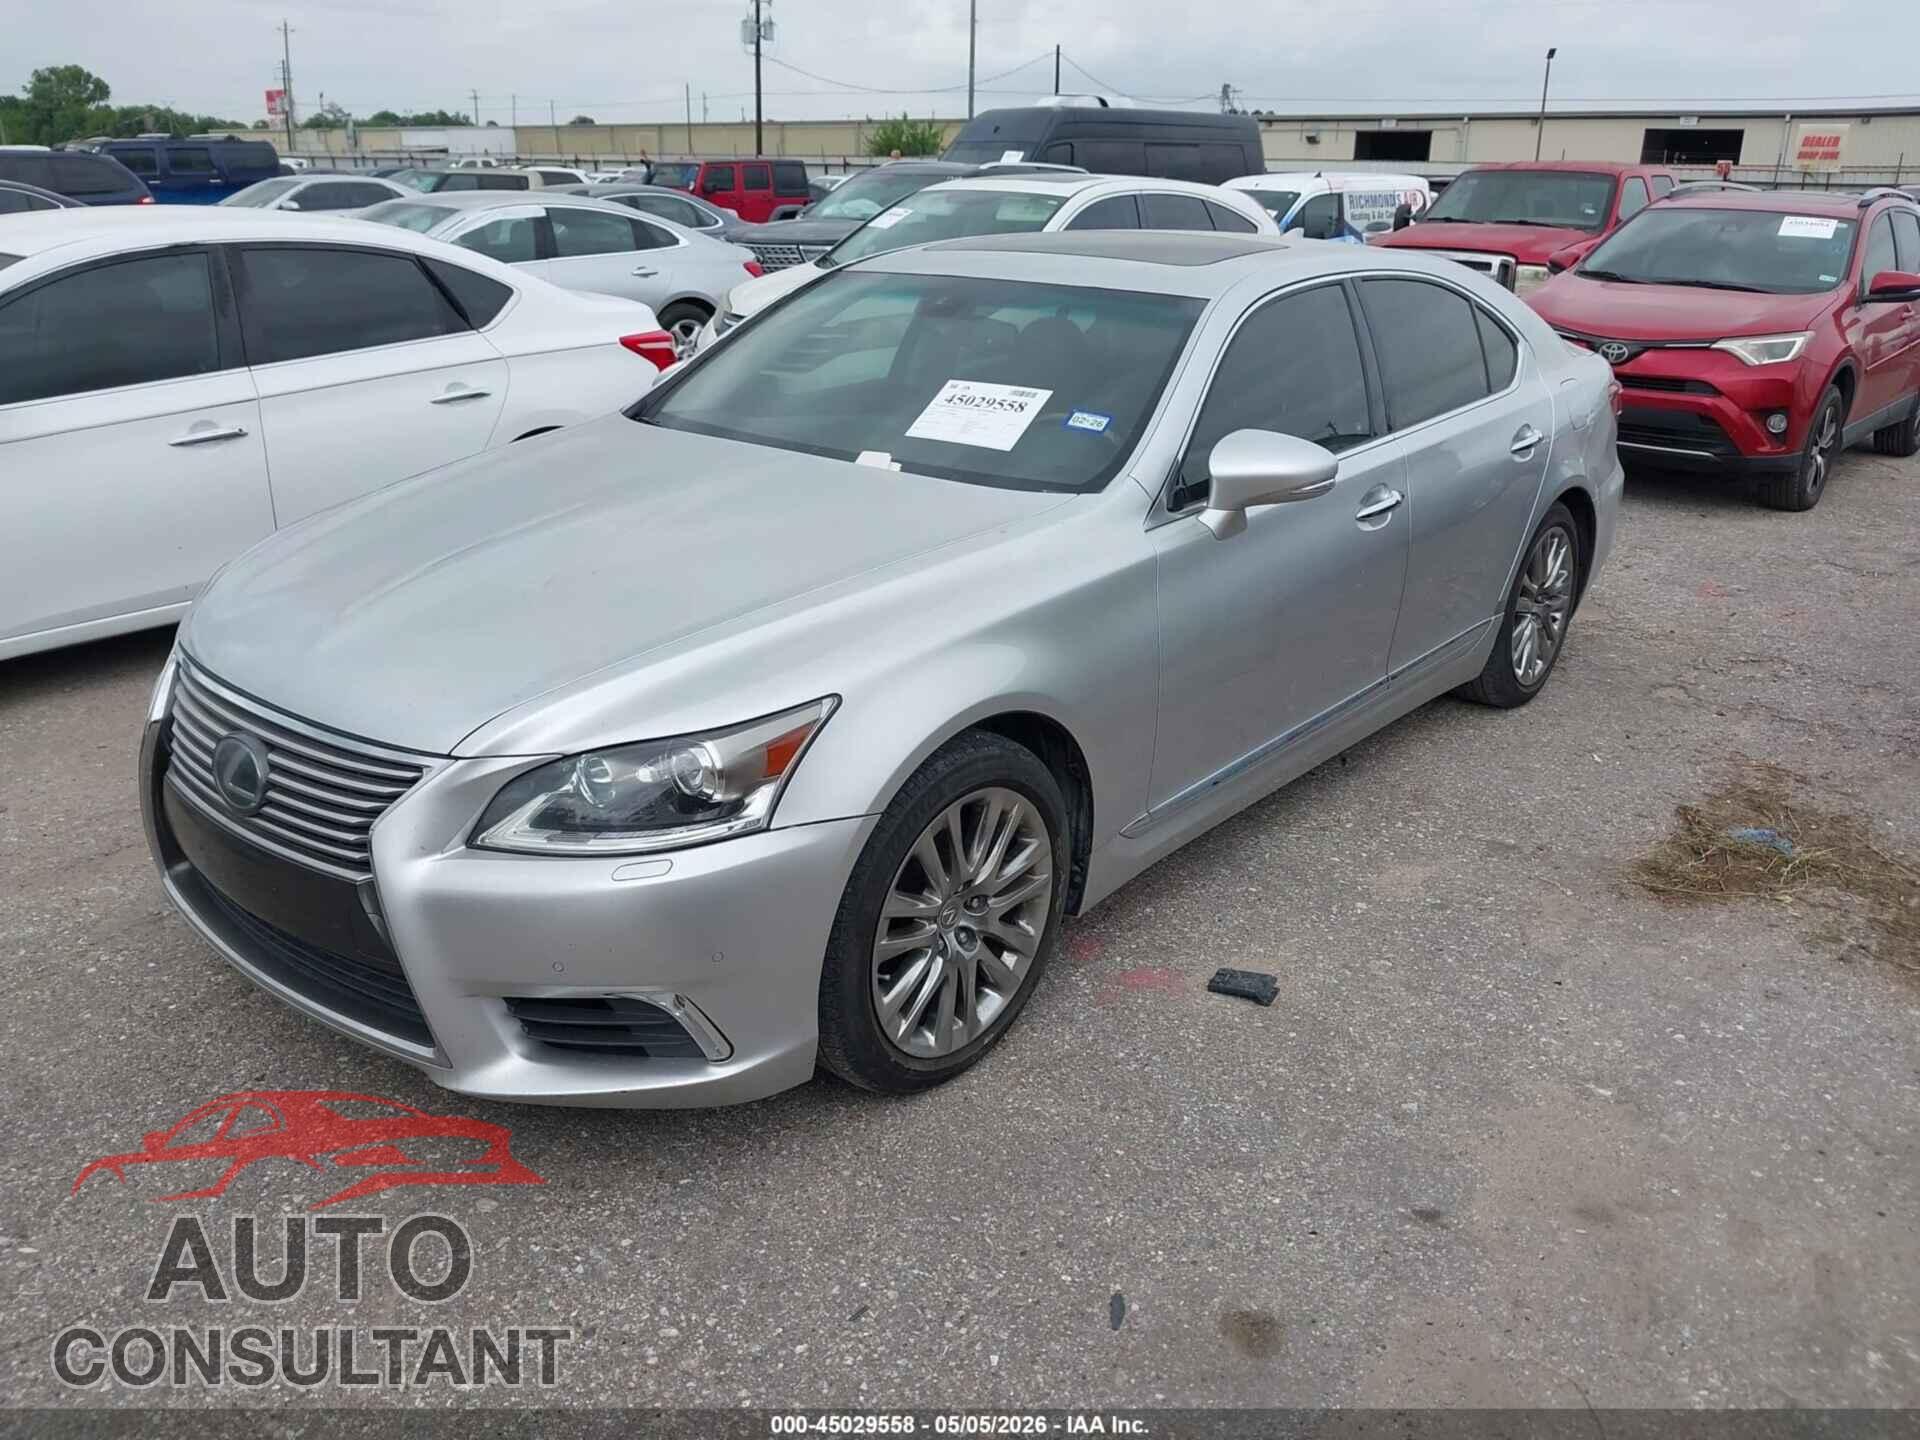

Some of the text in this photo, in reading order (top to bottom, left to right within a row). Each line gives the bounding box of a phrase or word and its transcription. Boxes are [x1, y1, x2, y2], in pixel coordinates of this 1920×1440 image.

[1801, 136, 1841, 147] DEALER
[1350, 211, 1370, 222] Heating
[943, 393, 1028, 414] 45029558
